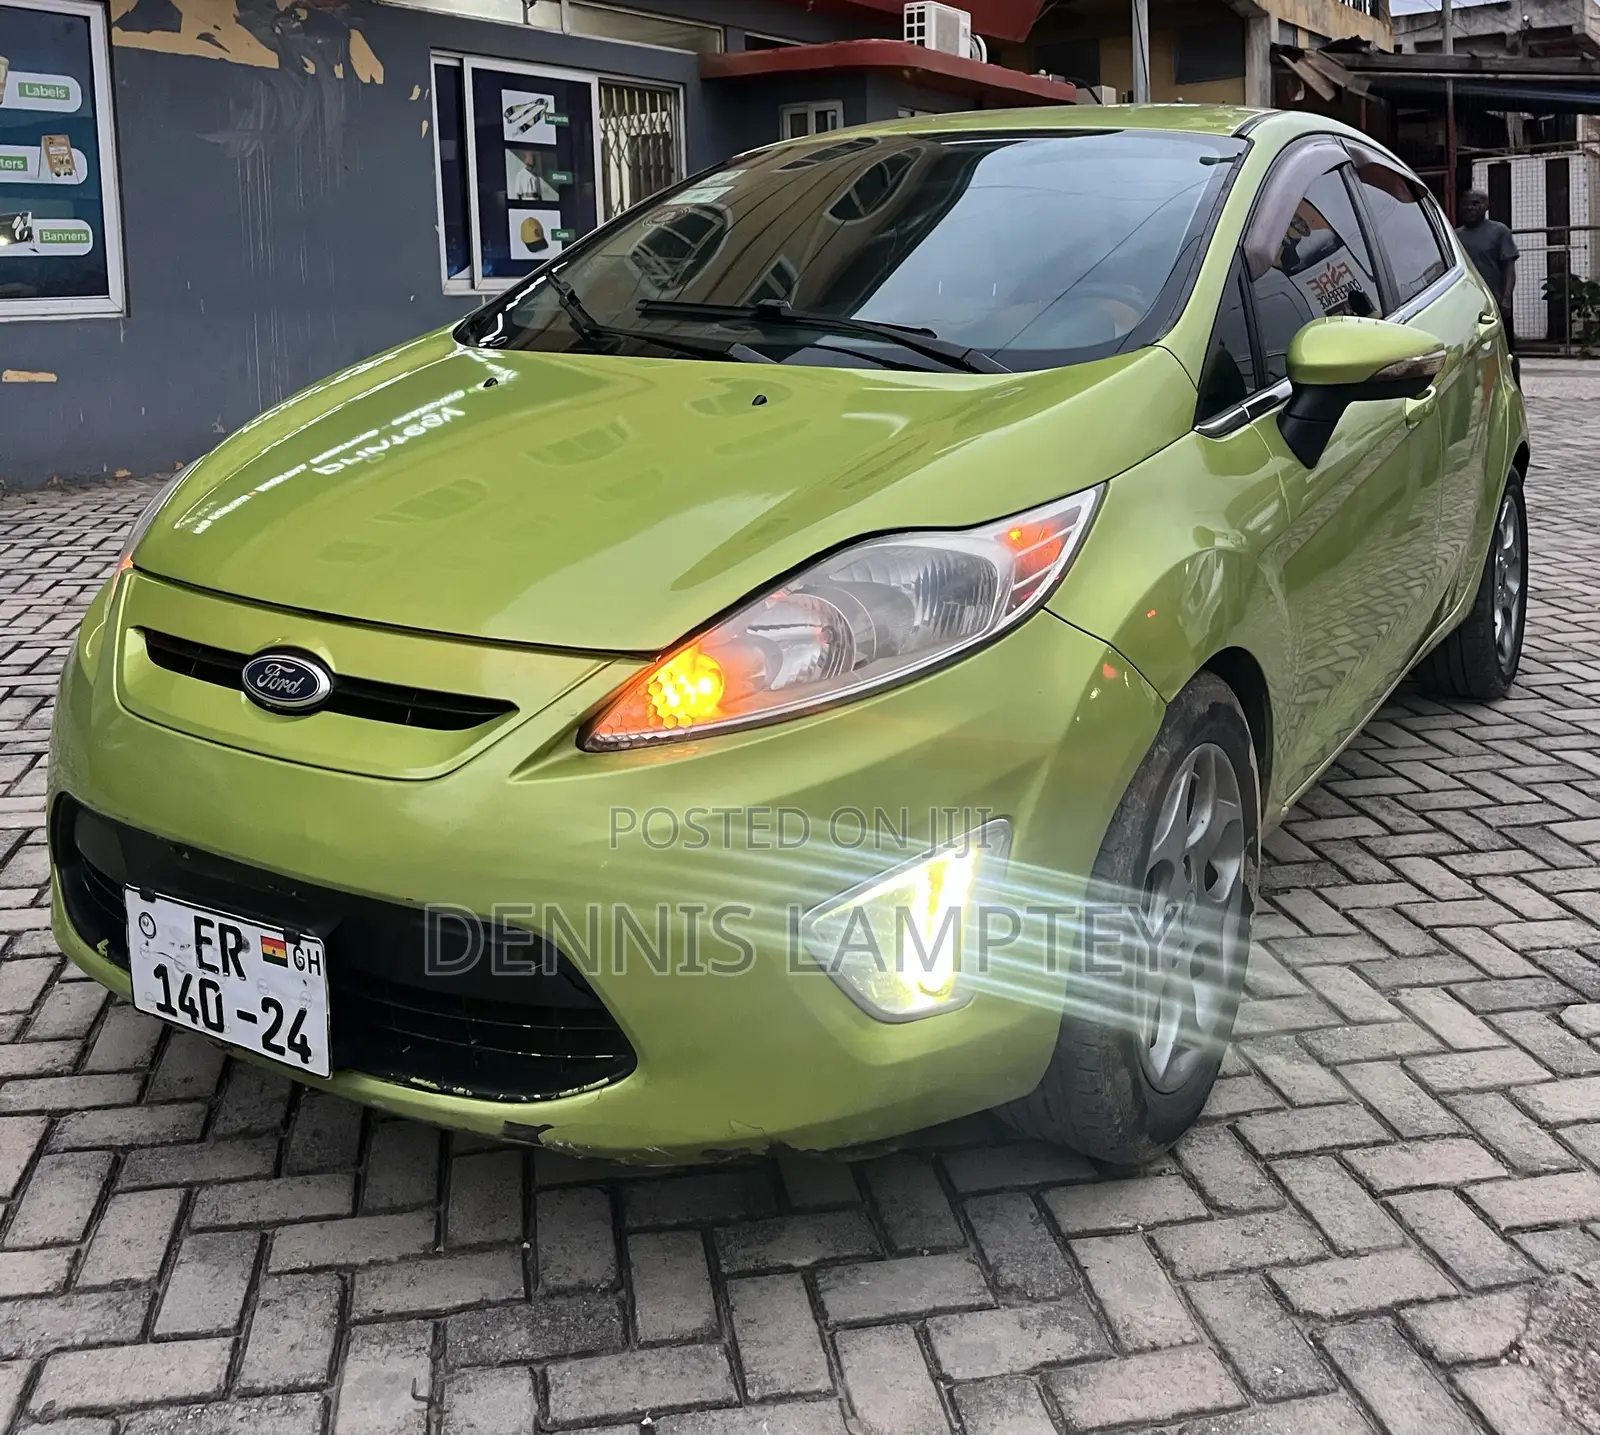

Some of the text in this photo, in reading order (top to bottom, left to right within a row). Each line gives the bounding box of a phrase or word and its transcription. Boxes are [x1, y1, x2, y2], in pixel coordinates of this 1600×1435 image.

[25, 84, 66, 98] Labels
[42, 231, 87, 241] Banners
[257, 663, 305, 694] Ford
[193, 915, 246, 980] ER
[293, 945, 321, 976] GH
